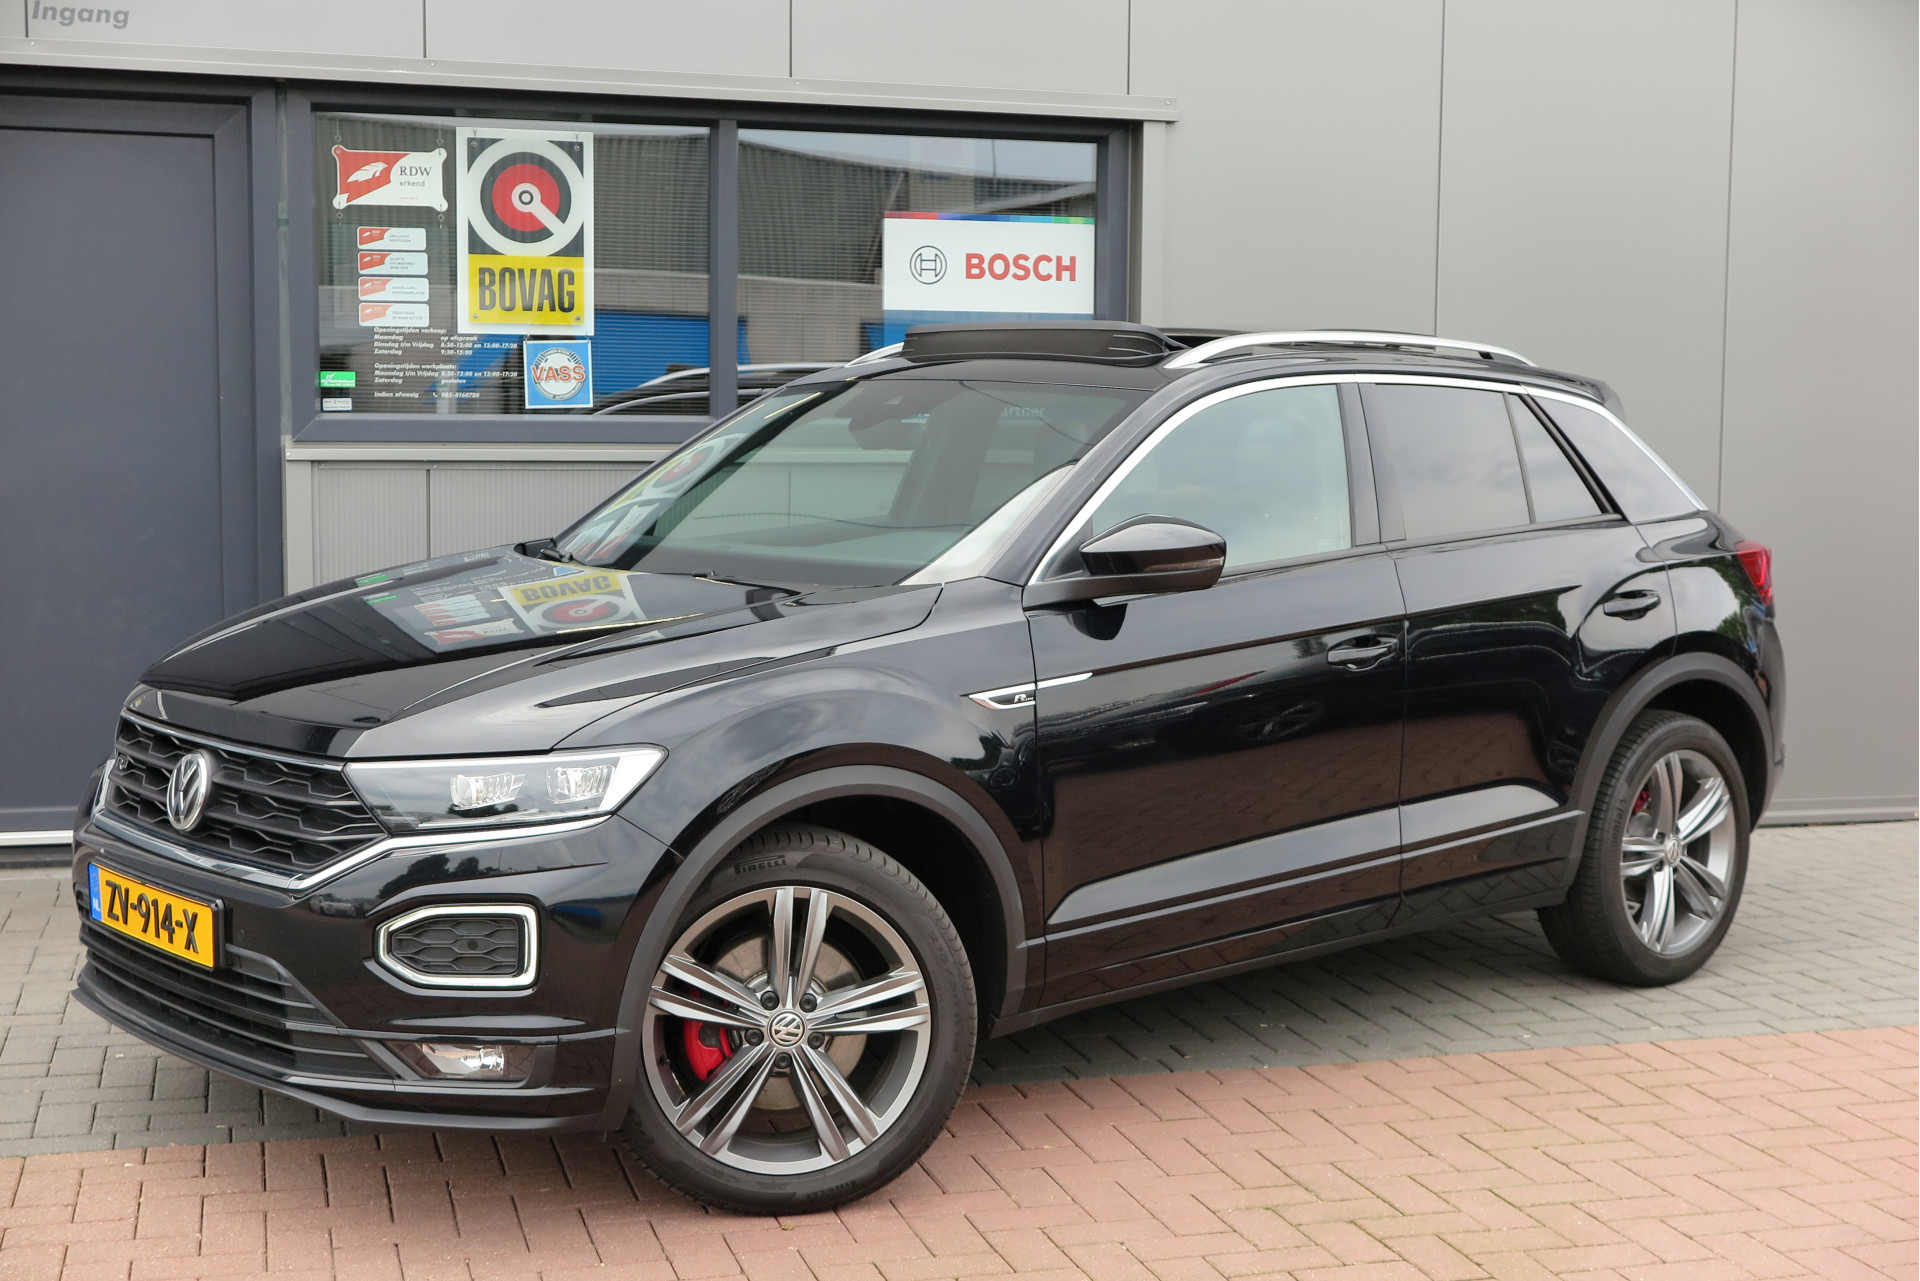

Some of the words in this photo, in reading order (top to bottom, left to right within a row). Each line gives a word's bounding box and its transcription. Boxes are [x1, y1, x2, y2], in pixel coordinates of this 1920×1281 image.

[32, 0, 130, 29] Ingang
[399, 166, 432, 176] RDW
[965, 253, 1076, 281] BOSCH
[478, 267, 575, 313] BOVAG
[373, 326, 420, 334] Openingstijden
[373, 362, 420, 370] Openingstijden
[373, 369, 404, 377] Maandag
[416, 370, 439, 378] Vrijdag
[531, 365, 586, 382] VASS
[1000, 406, 1046, 417] artner
[734, 854, 786, 875] PIRELLI
[105, 879, 200, 955] ZV-914-X
